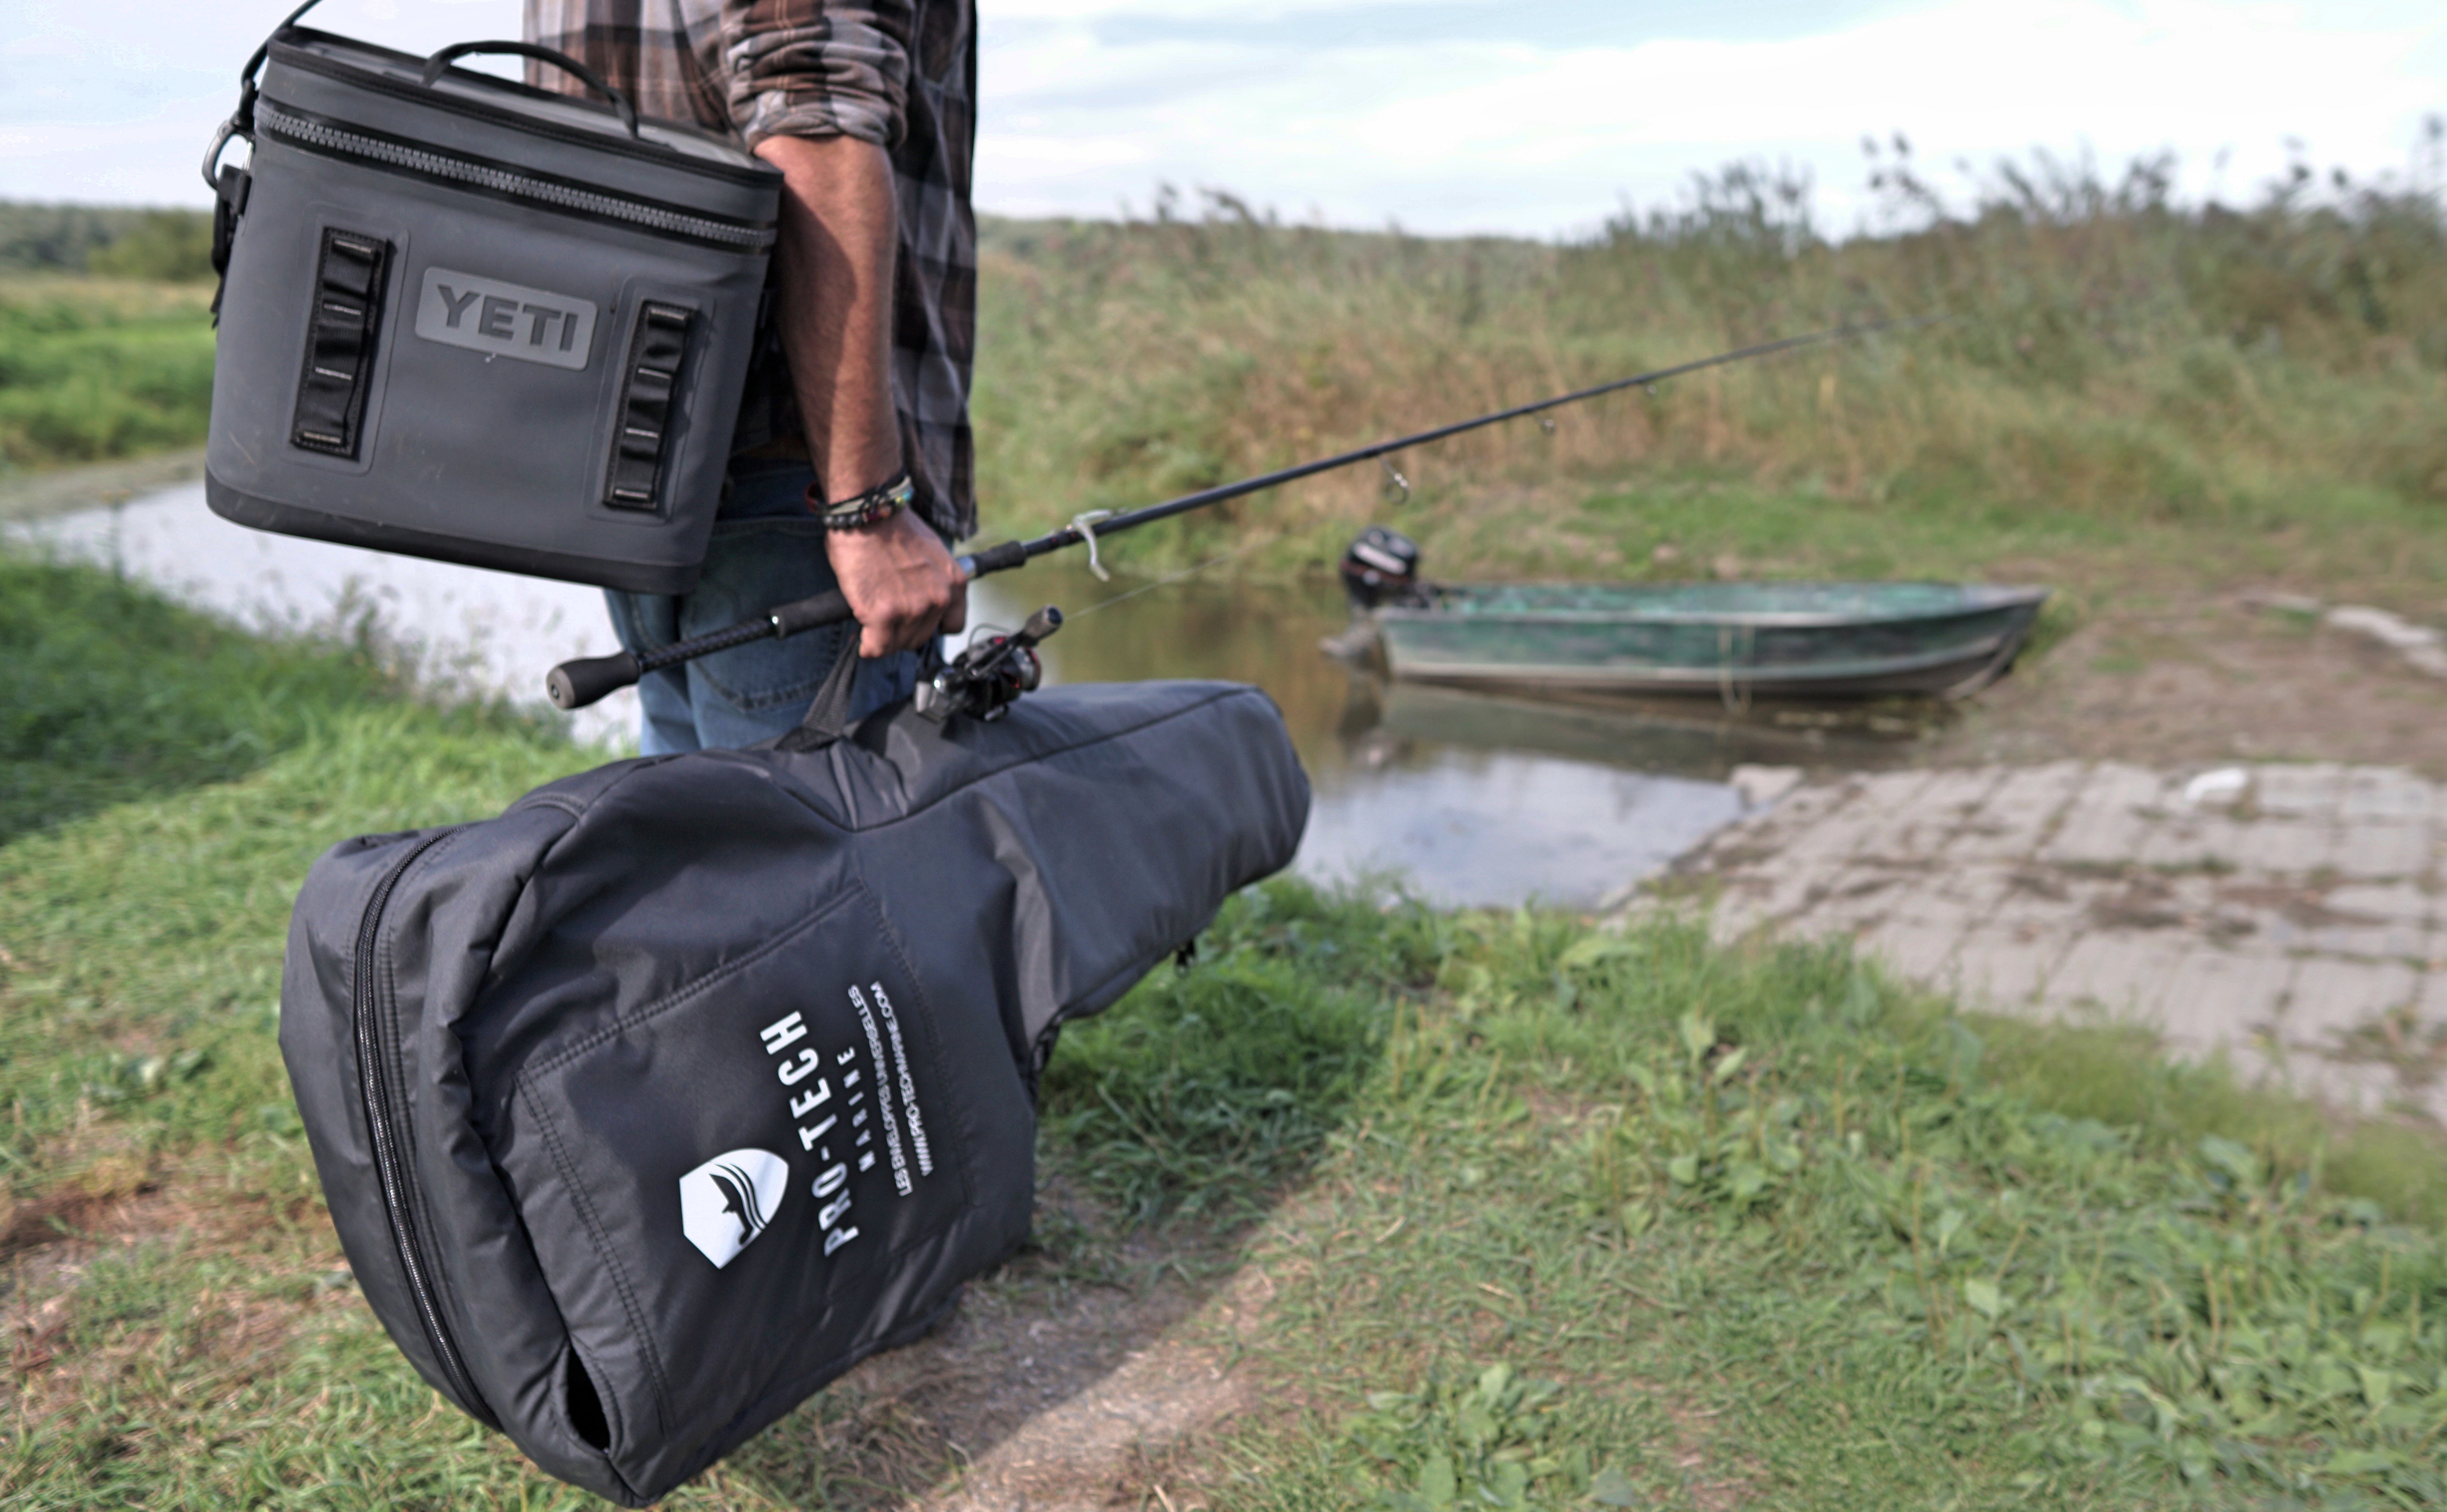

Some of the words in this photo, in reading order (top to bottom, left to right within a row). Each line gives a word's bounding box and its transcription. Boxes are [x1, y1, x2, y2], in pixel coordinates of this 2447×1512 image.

[437, 284, 578, 352] YETI
[848, 984, 889, 1087] UNIVERSELLES
[760, 1010, 859, 1257] PRO-TECH
[836, 1046, 876, 1173] MARINE
[878, 1084, 907, 1170] ENVELOPPES
[894, 1167, 913, 1197] LES
